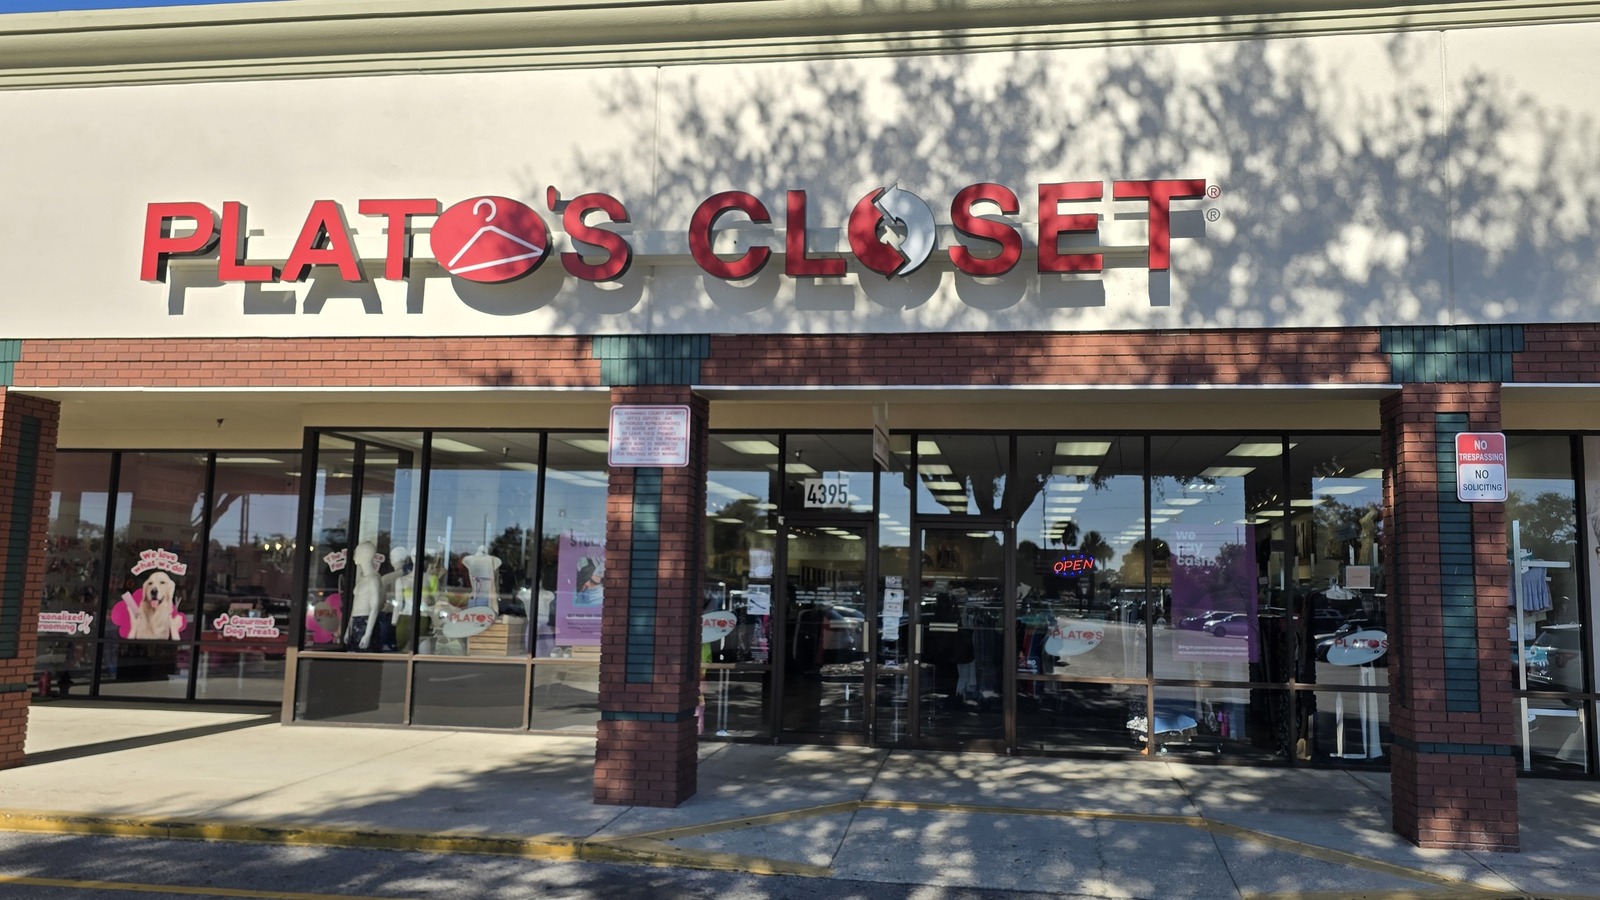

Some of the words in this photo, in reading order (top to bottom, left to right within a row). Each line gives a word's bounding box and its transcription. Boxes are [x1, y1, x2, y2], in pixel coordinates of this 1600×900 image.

[141, 185, 632, 282] PLATO'S
[689, 179, 1206, 279] CLOSET
[1474, 440, 1487, 450] NO
[1459, 453, 1503, 461] TRESPASSING
[1475, 470, 1489, 479] NO
[807, 484, 848, 504] 4395
[1176, 531, 1196, 540] we
[1177, 542, 1204, 556] pay
[1053, 558, 1094, 572] OPEN
[232, 617, 272, 626] Gourmet
[225, 627, 244, 636] Dog
[247, 627, 277, 635] Treats
